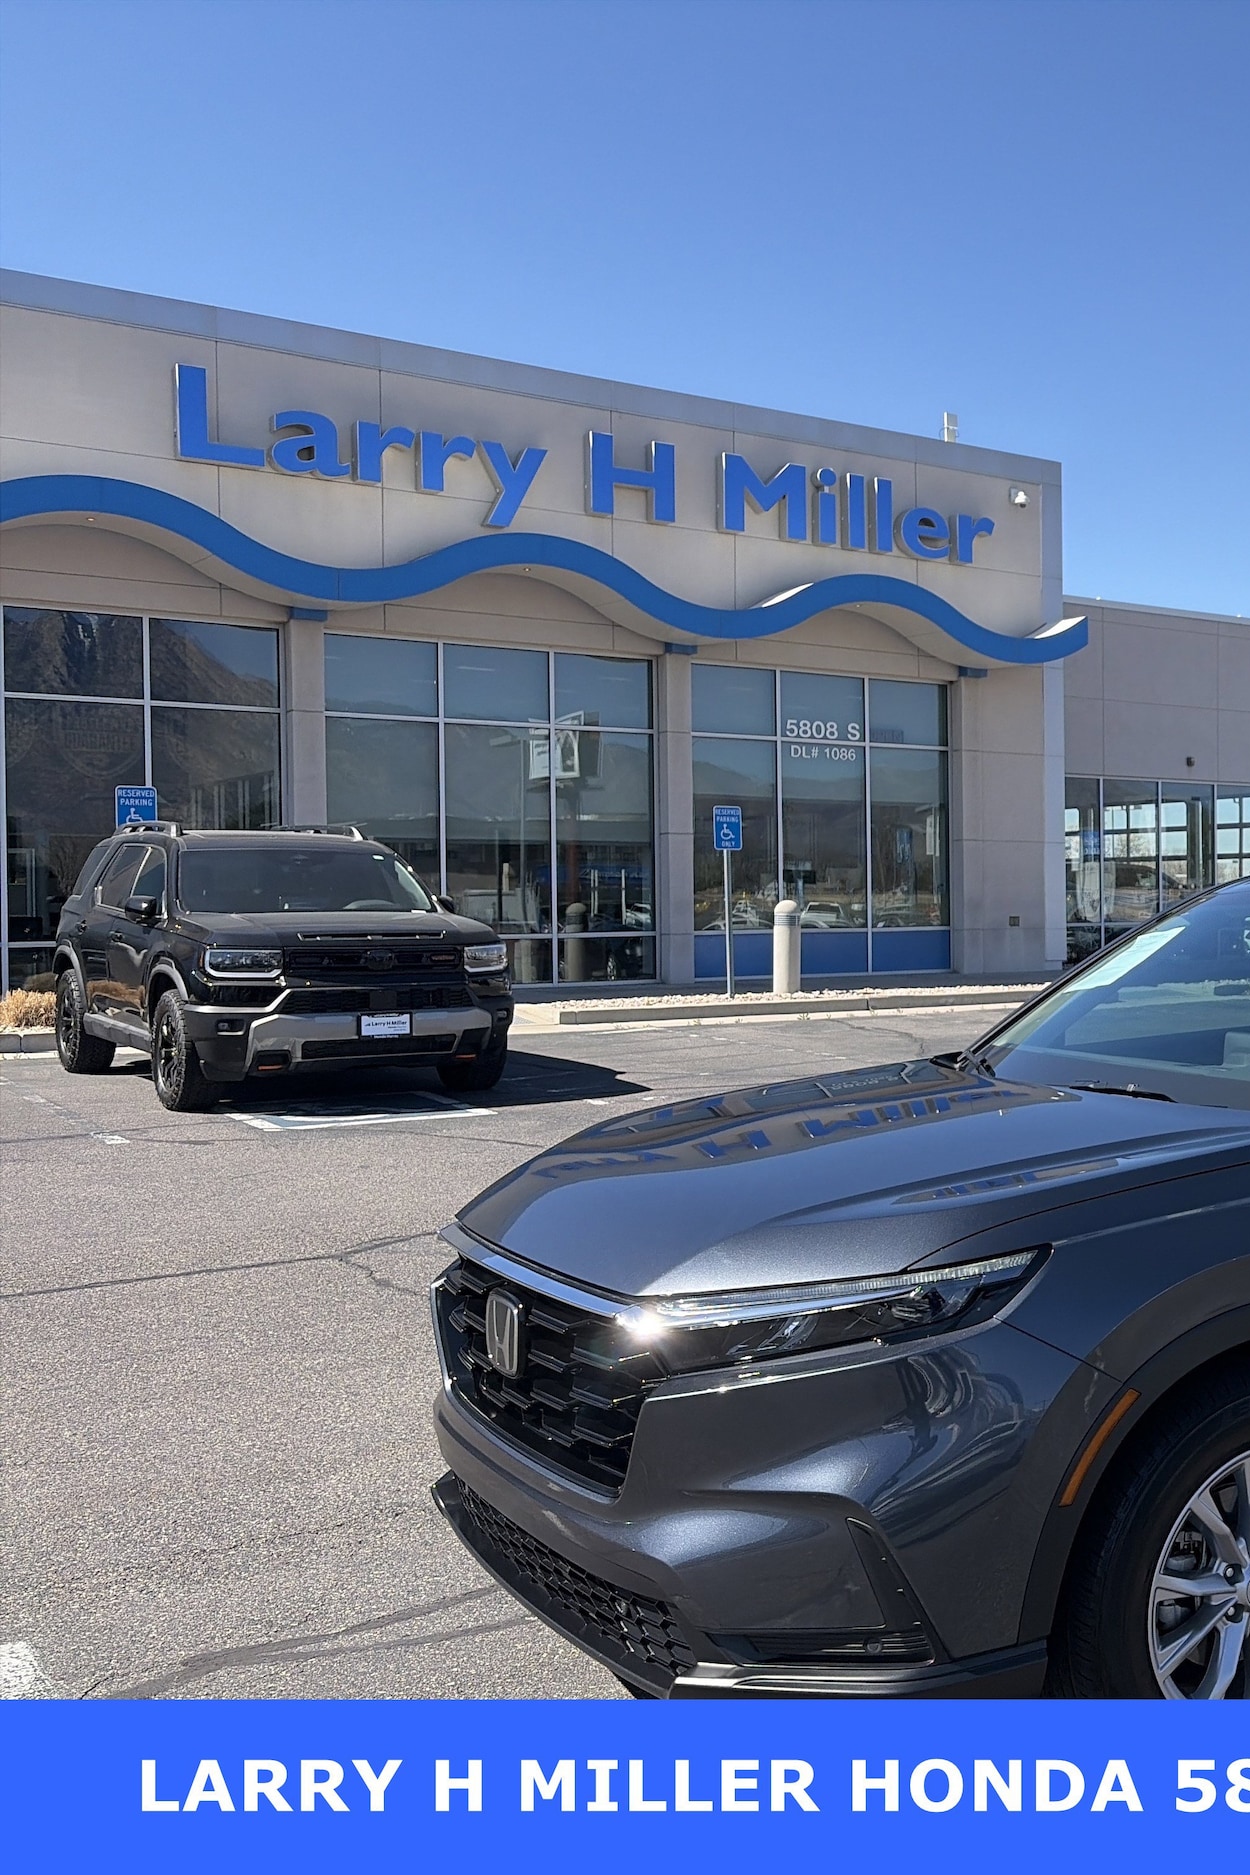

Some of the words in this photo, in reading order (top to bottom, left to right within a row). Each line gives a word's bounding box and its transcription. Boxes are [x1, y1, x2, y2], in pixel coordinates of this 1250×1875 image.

[175, 362, 548, 527] Larry
[586, 430, 675, 523] H
[717, 451, 995, 565] Miller
[786, 719, 838, 740] 5808
[847, 722, 860, 741] S
[790, 744, 819, 759] DL#
[824, 747, 856, 761] 1086
[117, 789, 155, 798] RESERVED
[120, 798, 153, 807] PARKING
[721, 840, 736, 848] ONLY
